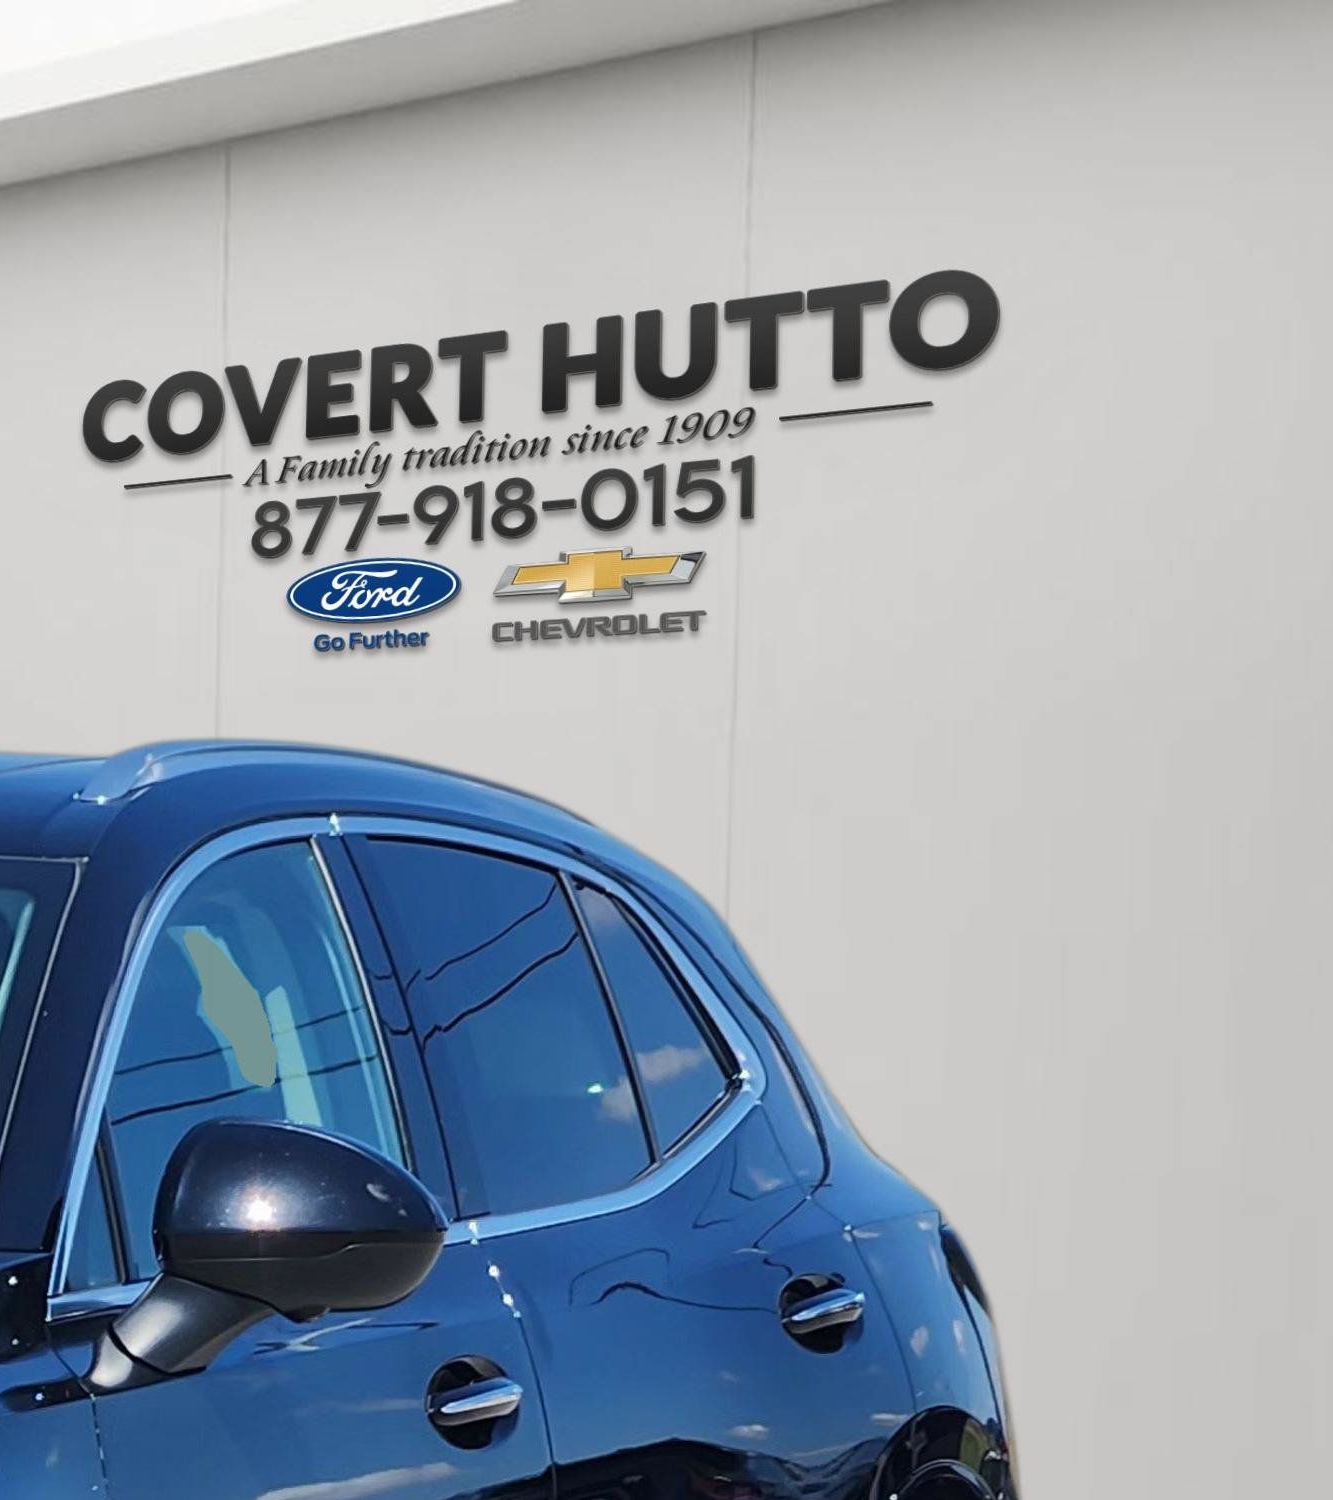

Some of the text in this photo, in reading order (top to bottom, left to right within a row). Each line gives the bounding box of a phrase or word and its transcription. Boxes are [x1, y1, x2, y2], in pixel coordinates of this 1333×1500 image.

[81, 268, 1002, 465] COVERT HUTTO
[241, 405, 757, 490] A Family tradition since 1909
[250, 454, 756, 561] 877-918-0151
[320, 569, 424, 611] Ford
[313, 628, 431, 653] Go Further
[491, 609, 708, 643] CHEVROLET
